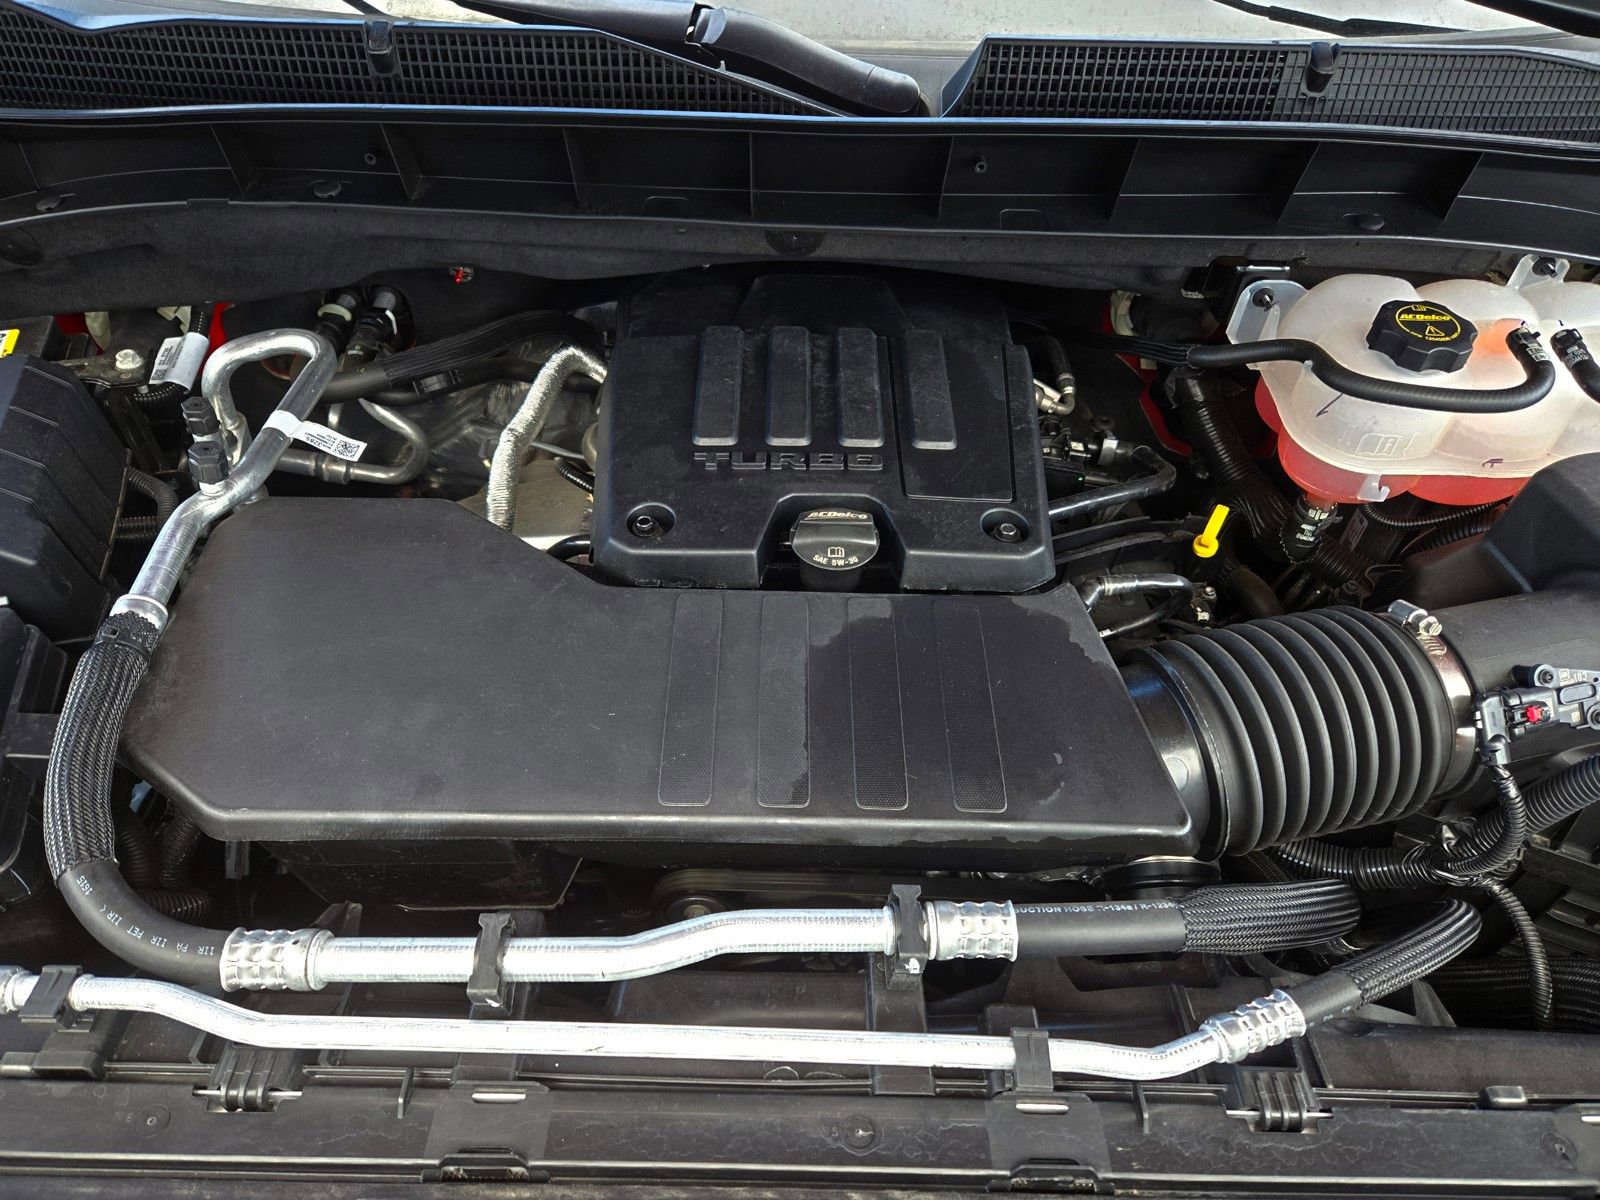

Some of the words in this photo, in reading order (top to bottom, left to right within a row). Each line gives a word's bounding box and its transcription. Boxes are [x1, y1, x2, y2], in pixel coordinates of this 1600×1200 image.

[1399, 313, 1451, 321] ACDelco
[693, 452, 884, 471] TURBO
[806, 511, 868, 520] ACDelco
[813, 554, 829, 565] SAE
[831, 556, 859, 566] 5W-30
[76, 875, 93, 896] 1615
[106, 912, 122, 926] IIR
[126, 925, 145, 939] PET
[150, 935, 168, 949] IIR
[176, 942, 189, 953] PA
[198, 946, 214, 956] IIR
